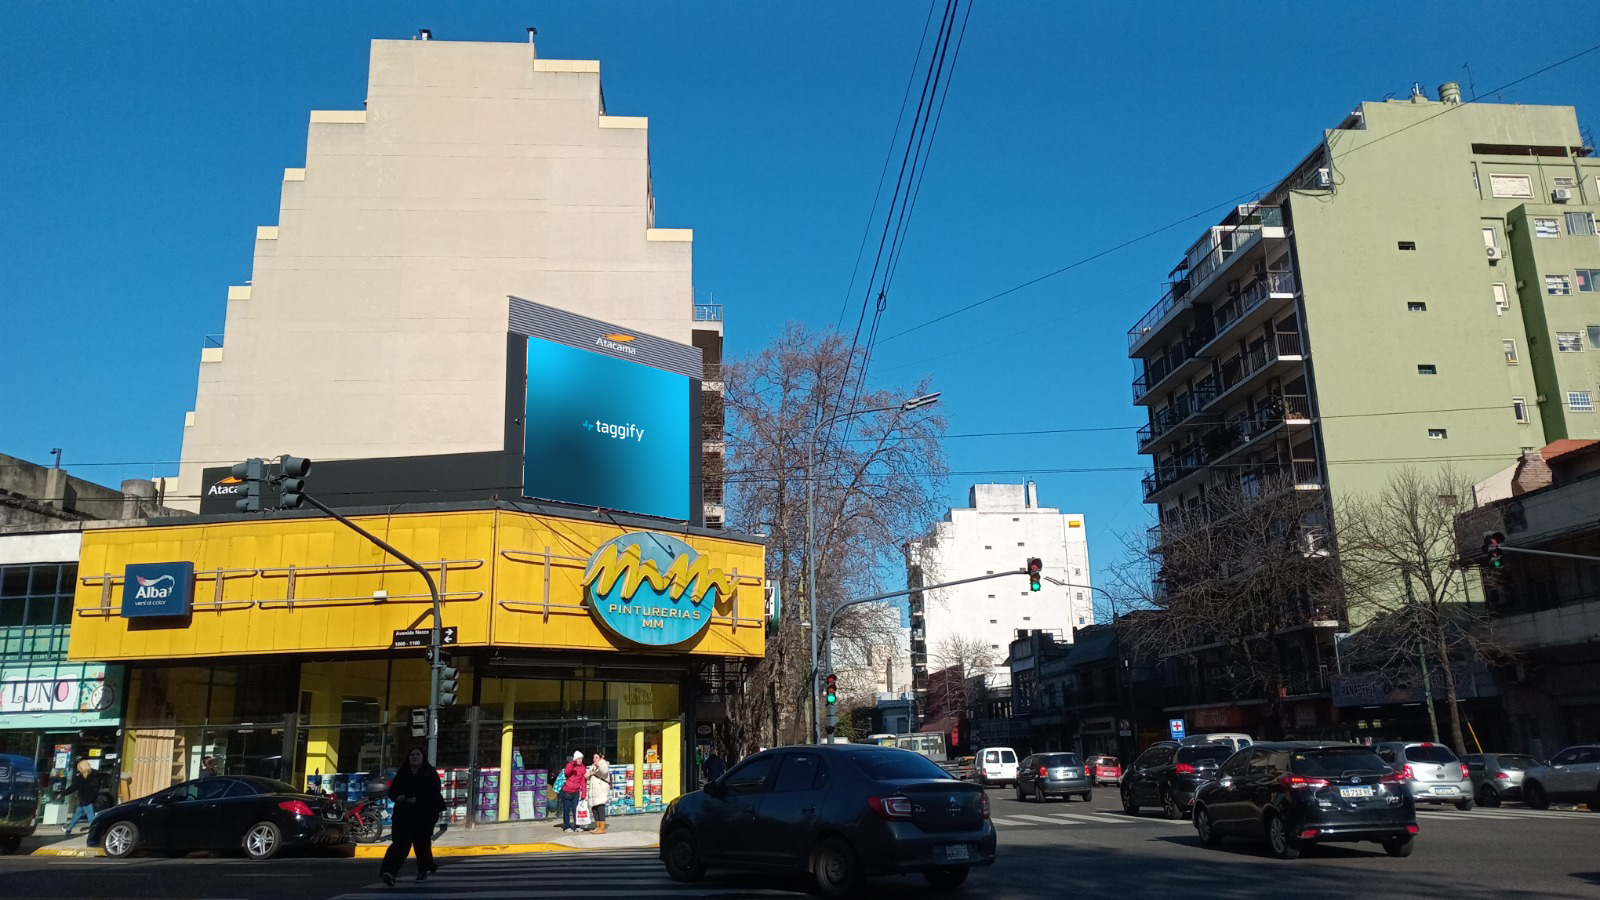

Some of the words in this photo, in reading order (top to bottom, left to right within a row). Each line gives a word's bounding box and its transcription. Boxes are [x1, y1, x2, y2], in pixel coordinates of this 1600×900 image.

[595, 337, 636, 355] Atacama
[595, 420, 645, 442] taggify
[208, 485, 238, 496] Atac
[135, 586, 167, 599] Alba
[608, 603, 701, 621] PINTURERIAS
[642, 618, 665, 629] MM
[10, 680, 70, 704] LUNO
